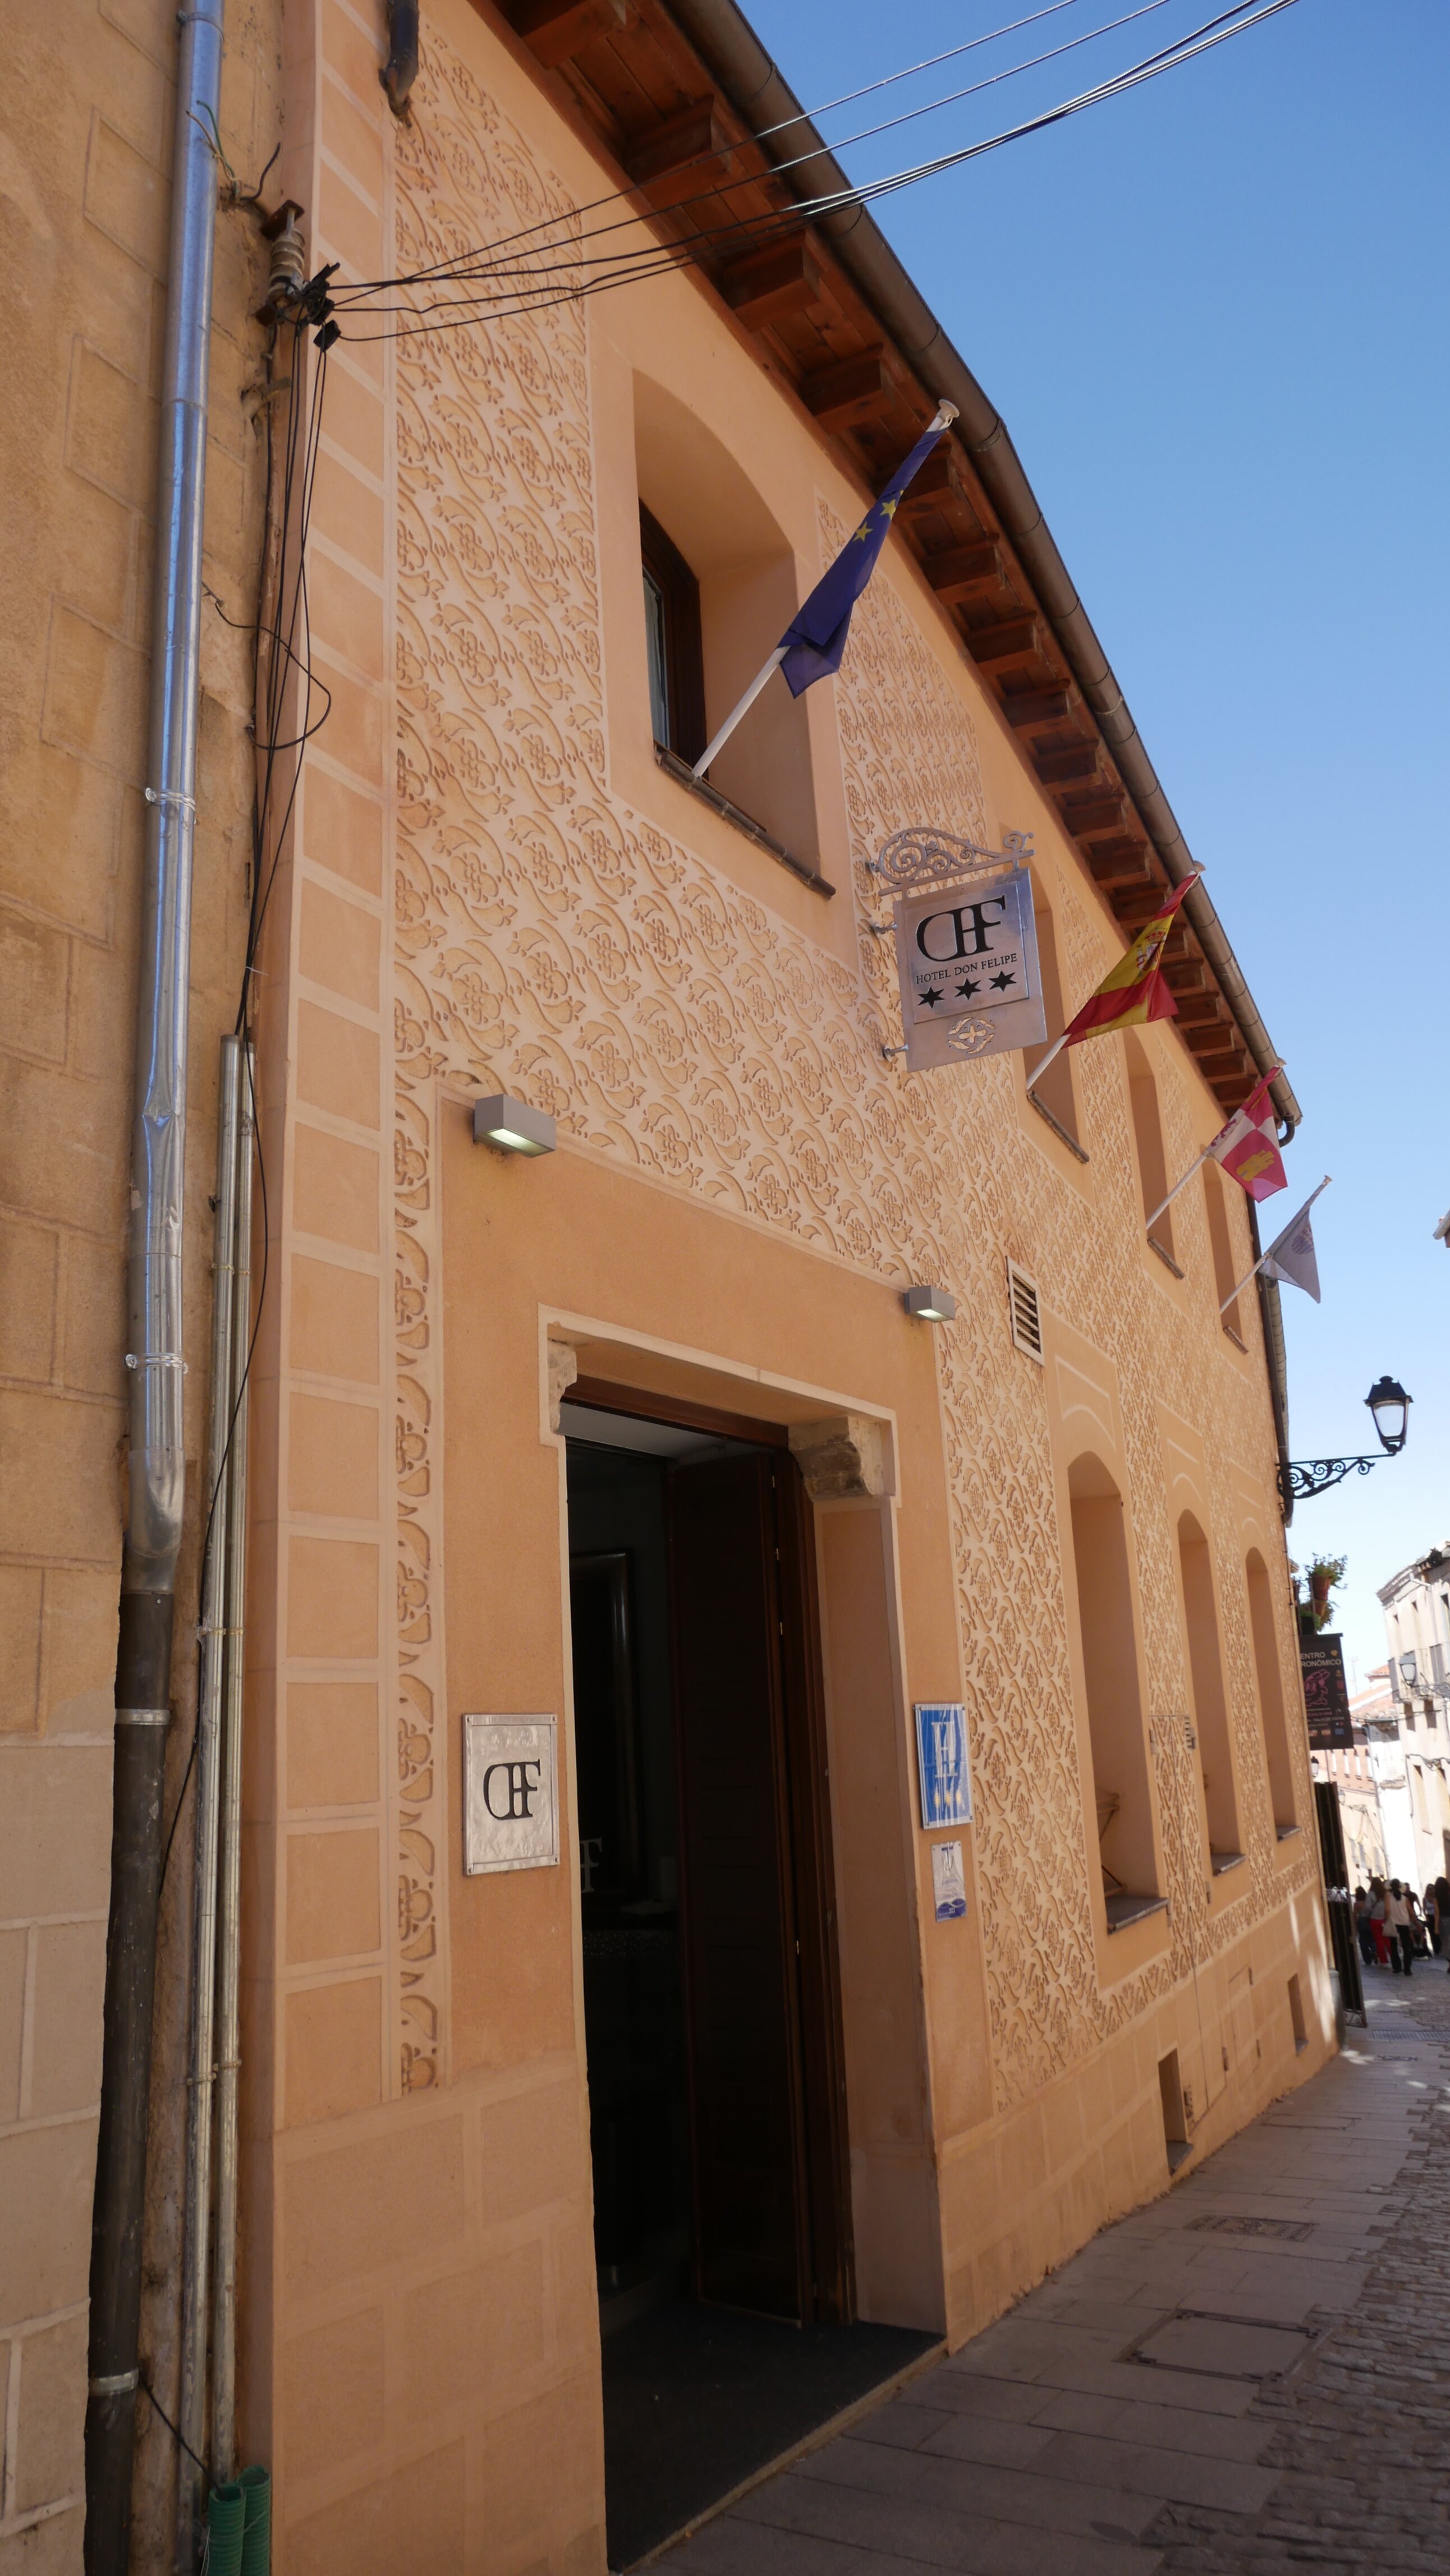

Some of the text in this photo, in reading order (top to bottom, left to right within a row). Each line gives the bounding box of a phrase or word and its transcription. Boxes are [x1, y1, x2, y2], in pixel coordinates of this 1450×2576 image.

[916, 953, 1017, 984] HOTEL DON FELIPE
[932, 1721, 958, 1778] H
